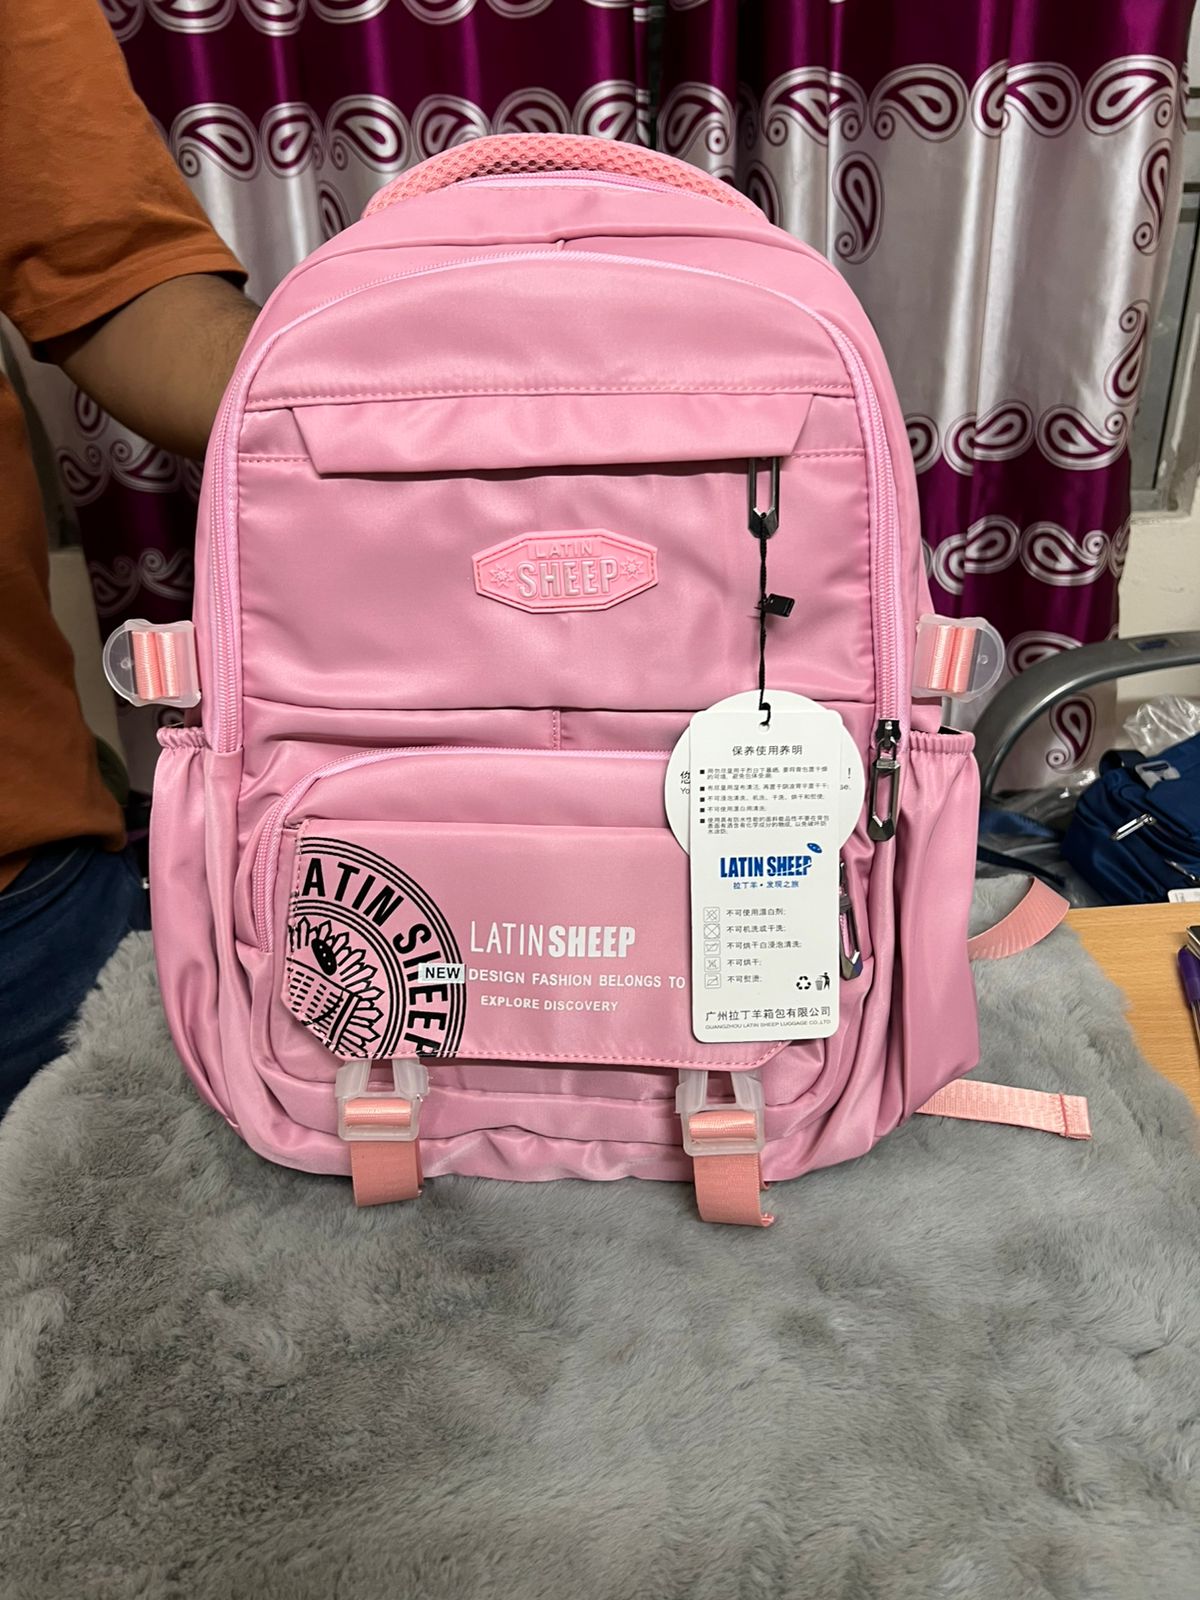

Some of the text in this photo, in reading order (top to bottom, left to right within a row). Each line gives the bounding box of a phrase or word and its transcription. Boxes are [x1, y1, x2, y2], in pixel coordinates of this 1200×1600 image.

[534, 541, 593, 559] LATIN
[517, 558, 618, 599] SHEEP
[720, 855, 813, 878] LATIN SHEEP
[291, 857, 404, 927] ATIN
[425, 967, 461, 979] NEW
[468, 968, 686, 989] DESIGN FASHION BELONGS TO
[480, 995, 619, 1012] EXPLORE DISCOVERY
[705, 1006, 831, 1022] 广州拉丁羊箱包有限公司
